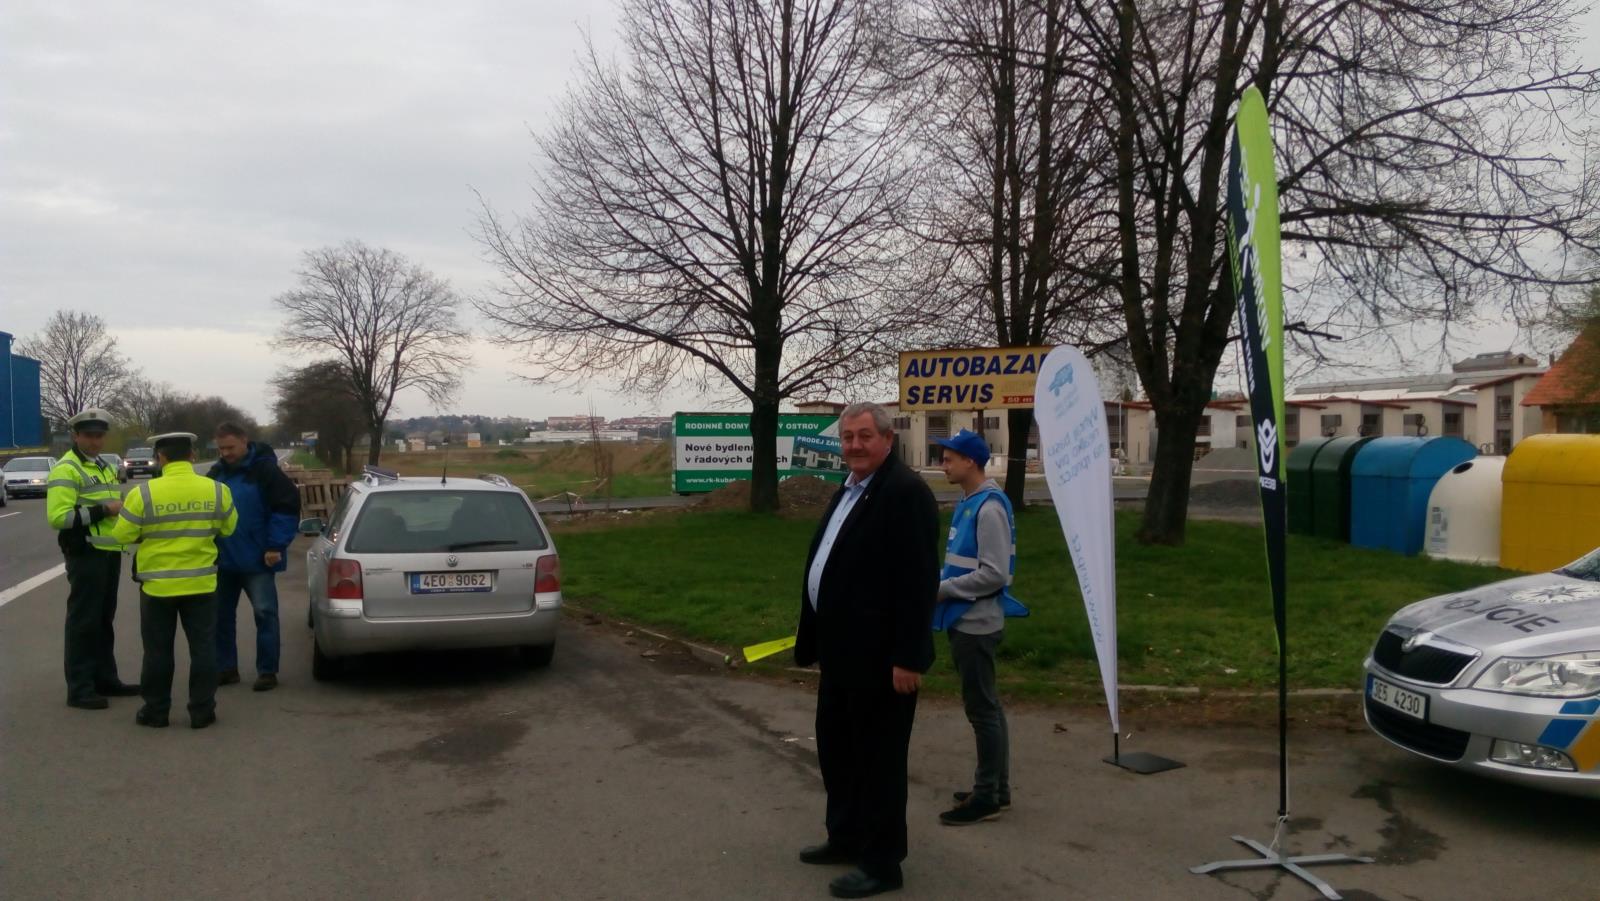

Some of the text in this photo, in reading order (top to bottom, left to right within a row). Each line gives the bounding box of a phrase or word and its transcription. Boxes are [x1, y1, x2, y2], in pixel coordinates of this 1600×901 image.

[906, 384, 994, 405] SERVIS
[725, 422, 749, 430] DOMY
[797, 436, 824, 444] PRODEJ
[685, 443, 712, 451] Nové
[694, 455, 743, 465] řadových
[155, 500, 215, 516] POLICIE
[456, 574, 486, 586] 9062
[1393, 690, 1420, 715] 4230
